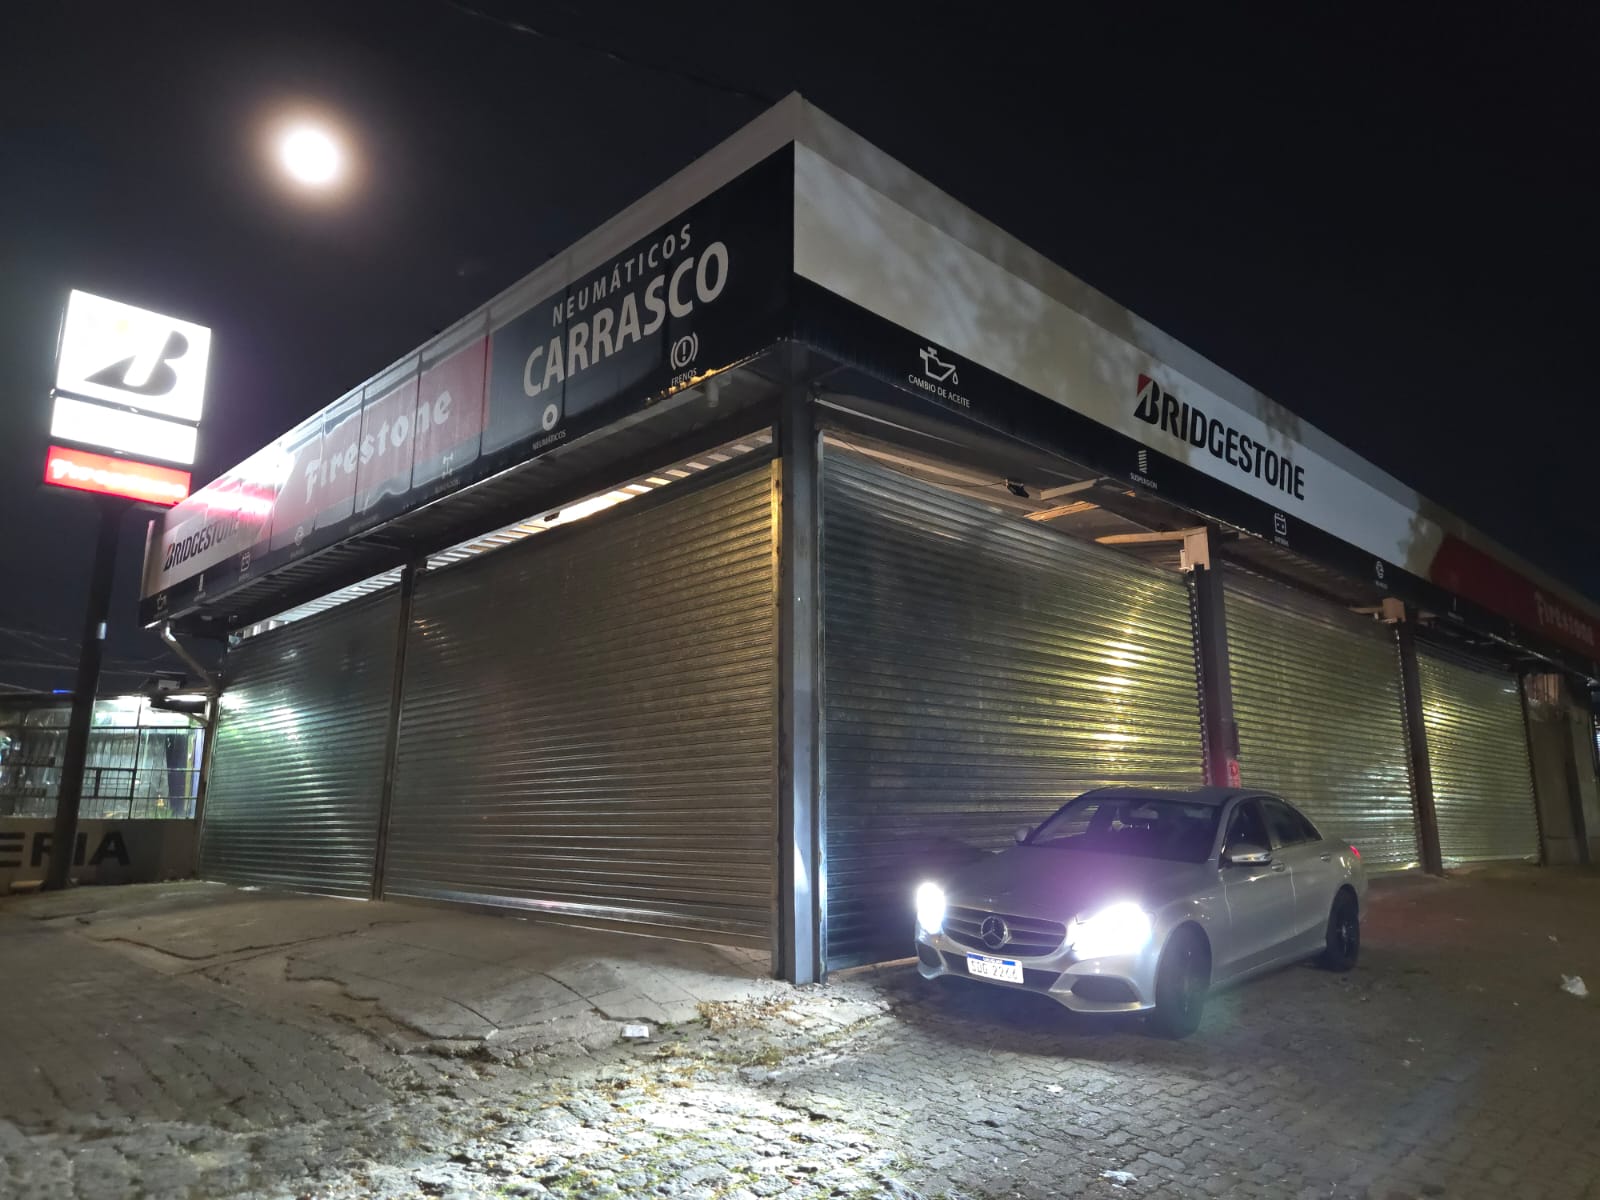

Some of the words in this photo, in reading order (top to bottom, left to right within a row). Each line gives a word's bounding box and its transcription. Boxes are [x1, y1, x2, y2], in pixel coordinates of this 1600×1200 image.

[523, 241, 729, 397] CARRASCO
[552, 223, 692, 327] NEUMÁTICOS
[671, 367, 697, 387] FRENOS
[908, 374, 936, 393] CAMBIO
[937, 386, 947, 399] DE
[948, 392, 971, 409] ACEITE
[304, 391, 453, 504] Firestone
[1133, 372, 1305, 501] BRIDGESTONE
